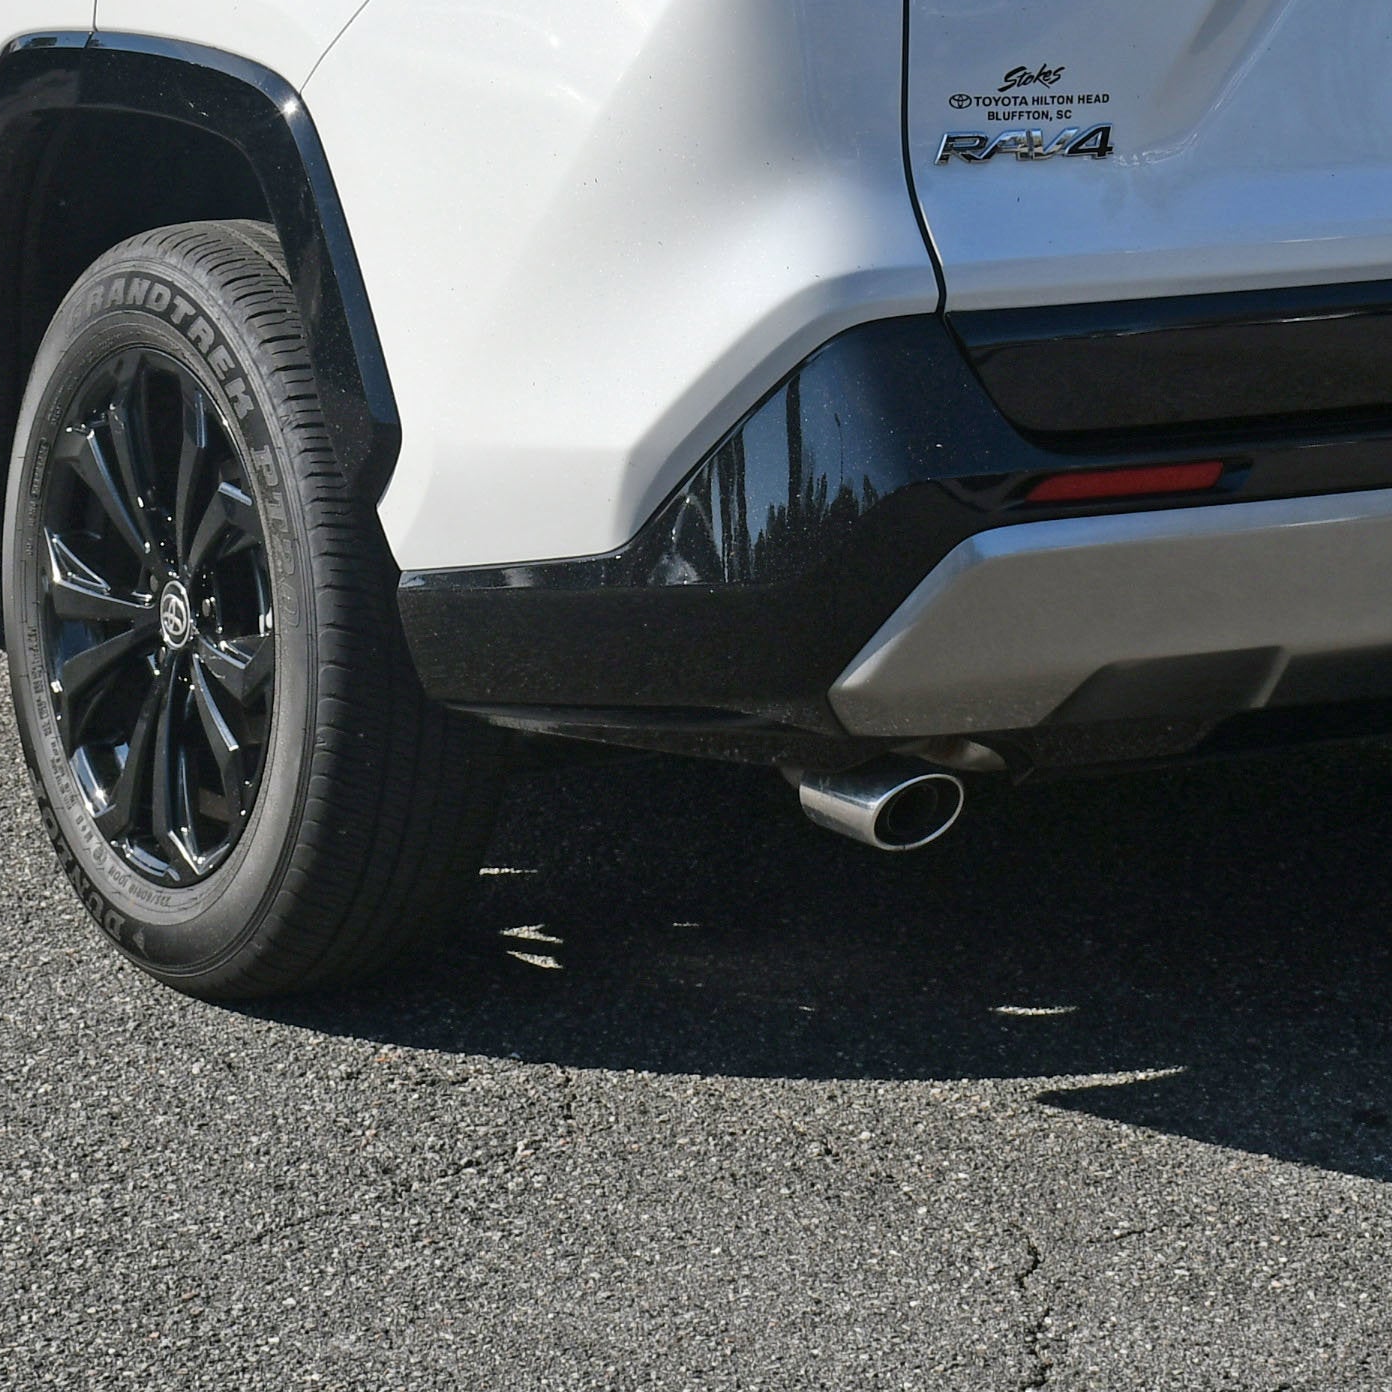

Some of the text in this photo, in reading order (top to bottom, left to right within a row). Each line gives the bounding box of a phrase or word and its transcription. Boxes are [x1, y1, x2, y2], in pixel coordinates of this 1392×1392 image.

[998, 64, 1065, 92] Stokes
[975, 94, 1109, 106] TOYOTA HILTON HEAD
[988, 110, 1072, 121] BLUFFTON, SC
[934, 122, 1114, 164] RAV4
[66, 277, 254, 420] GRANDTREK
